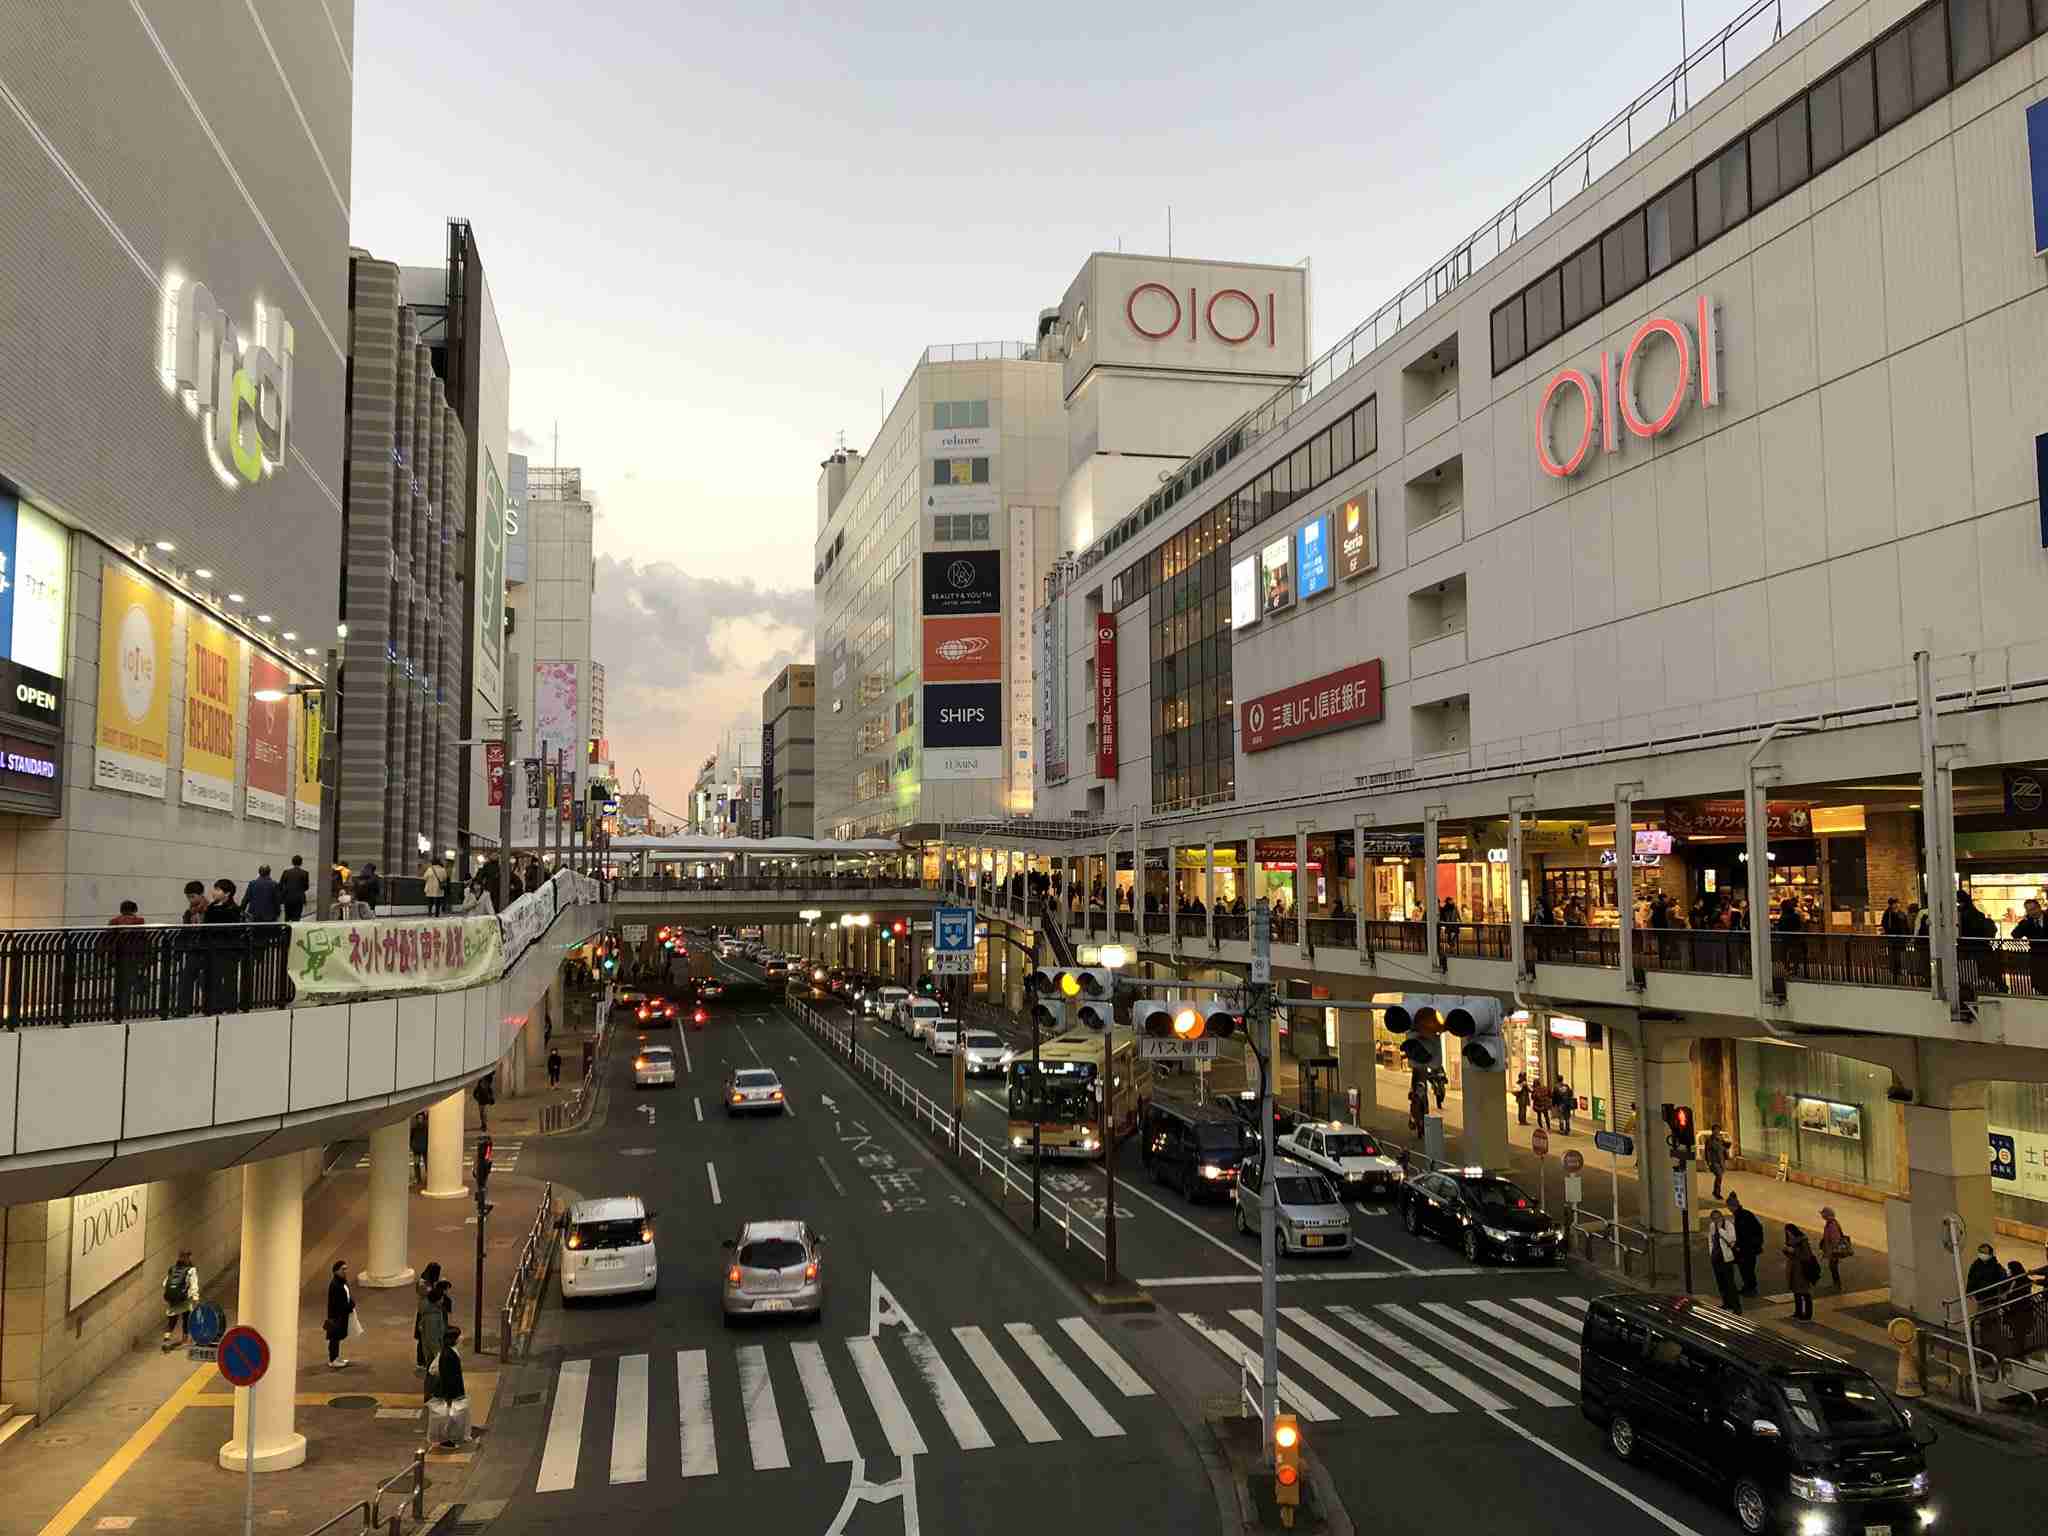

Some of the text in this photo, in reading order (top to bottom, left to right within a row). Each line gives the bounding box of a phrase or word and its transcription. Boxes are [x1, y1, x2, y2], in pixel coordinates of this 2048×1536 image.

[16, 684, 56, 710] OPEN
[195, 643, 229, 706] TOWER
[189, 696, 233, 760] RECORDS
[939, 707, 985, 724] SHIPS
[1271, 680, 1368, 731] 三菱UFJ信託銀行
[7, 753, 54, 778] STANDARD
[81, 1190, 139, 1257] DOORS
